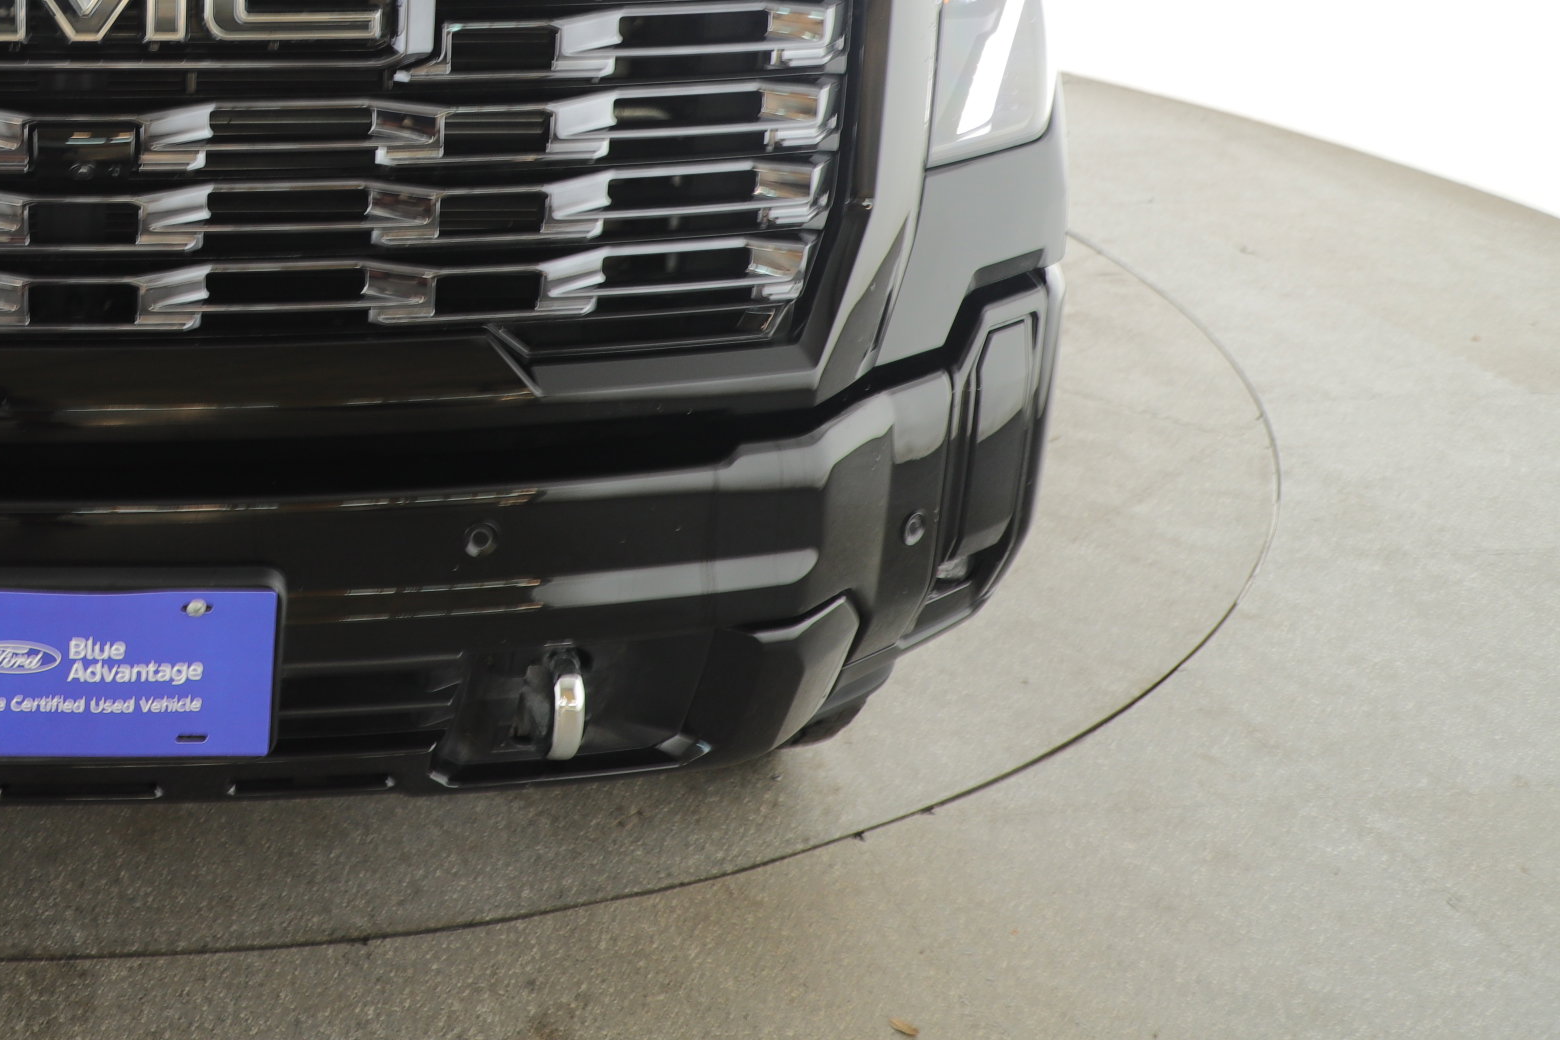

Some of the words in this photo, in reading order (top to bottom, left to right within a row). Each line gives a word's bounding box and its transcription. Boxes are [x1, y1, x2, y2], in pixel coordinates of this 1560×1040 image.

[68, 637, 126, 660] Blue
[68, 660, 204, 685] Advantage
[10, 694, 85, 713] Certified
[90, 696, 135, 713] Used
[139, 695, 202, 713] Vehicle
